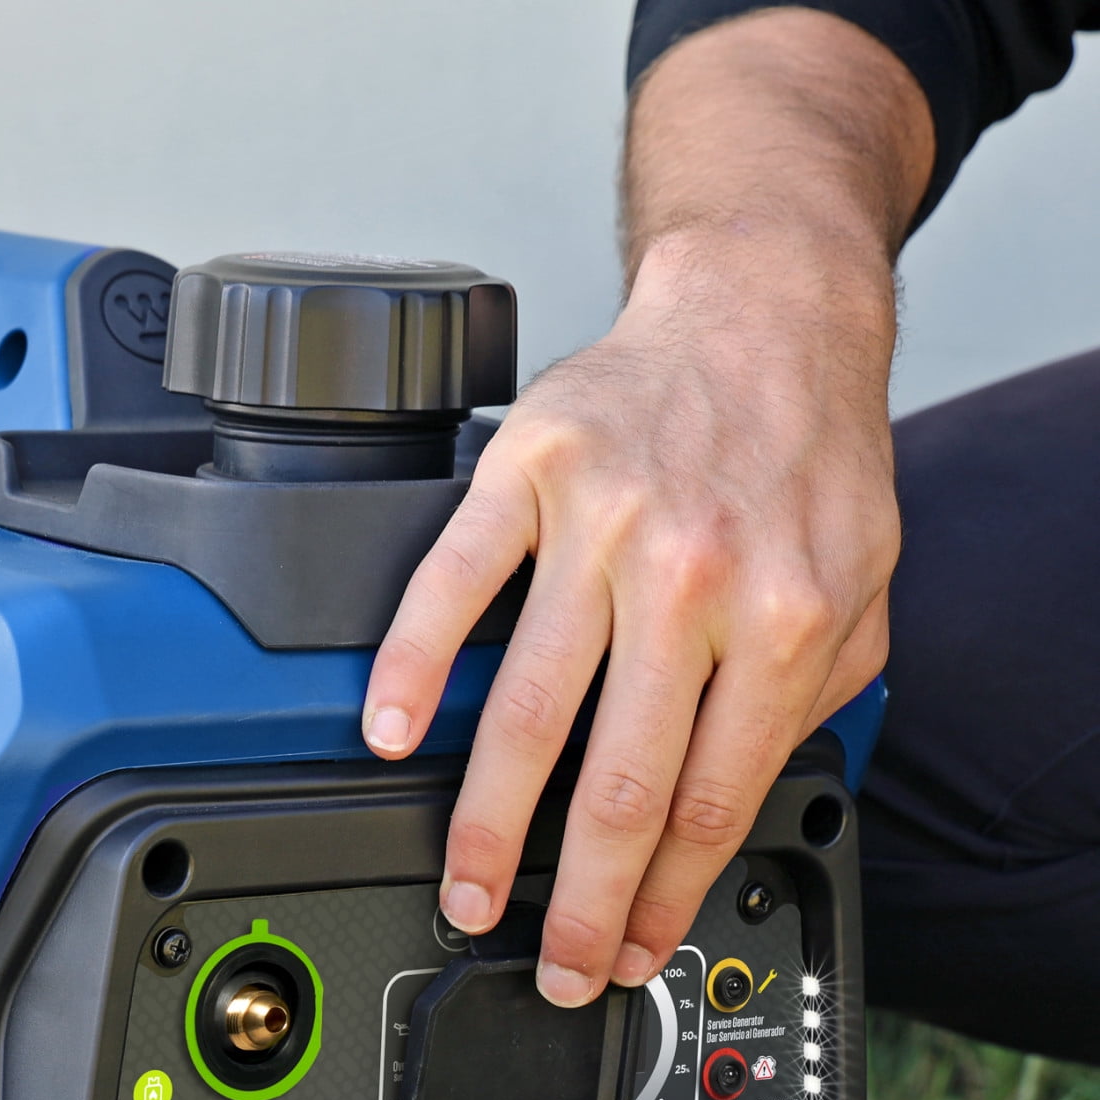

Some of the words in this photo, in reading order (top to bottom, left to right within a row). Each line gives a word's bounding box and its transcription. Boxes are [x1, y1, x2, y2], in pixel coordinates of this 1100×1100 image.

[707, 1018, 731, 1031] Service
[732, 1015, 765, 1028] Generator
[706, 1032, 718, 1043] Dar
[718, 1030, 745, 1042] Servicio
[745, 1028, 752, 1039] al
[752, 1025, 786, 1038] Generador
